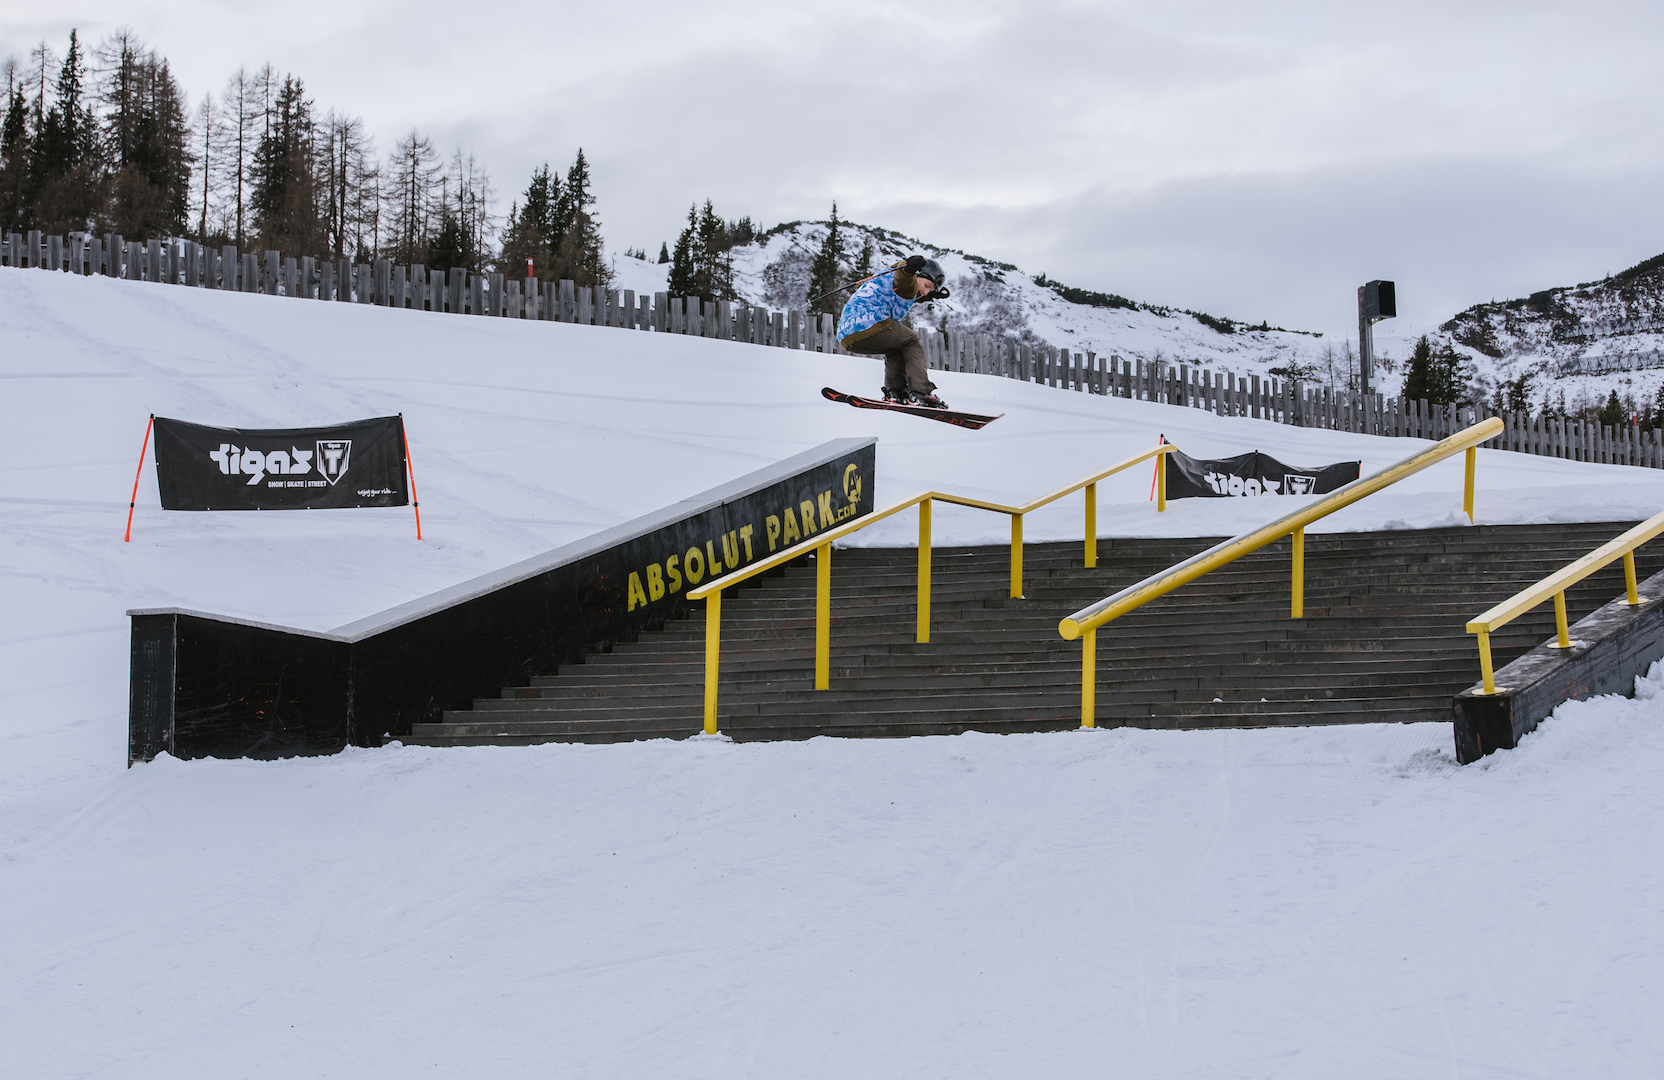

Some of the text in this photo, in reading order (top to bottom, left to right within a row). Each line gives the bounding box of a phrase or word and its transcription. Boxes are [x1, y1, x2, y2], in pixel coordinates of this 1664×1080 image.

[209, 443, 314, 486] tigas
[287, 480, 304, 488] SKATE
[627, 523, 754, 613] ABSOLUT
[765, 490, 836, 552] PARK
